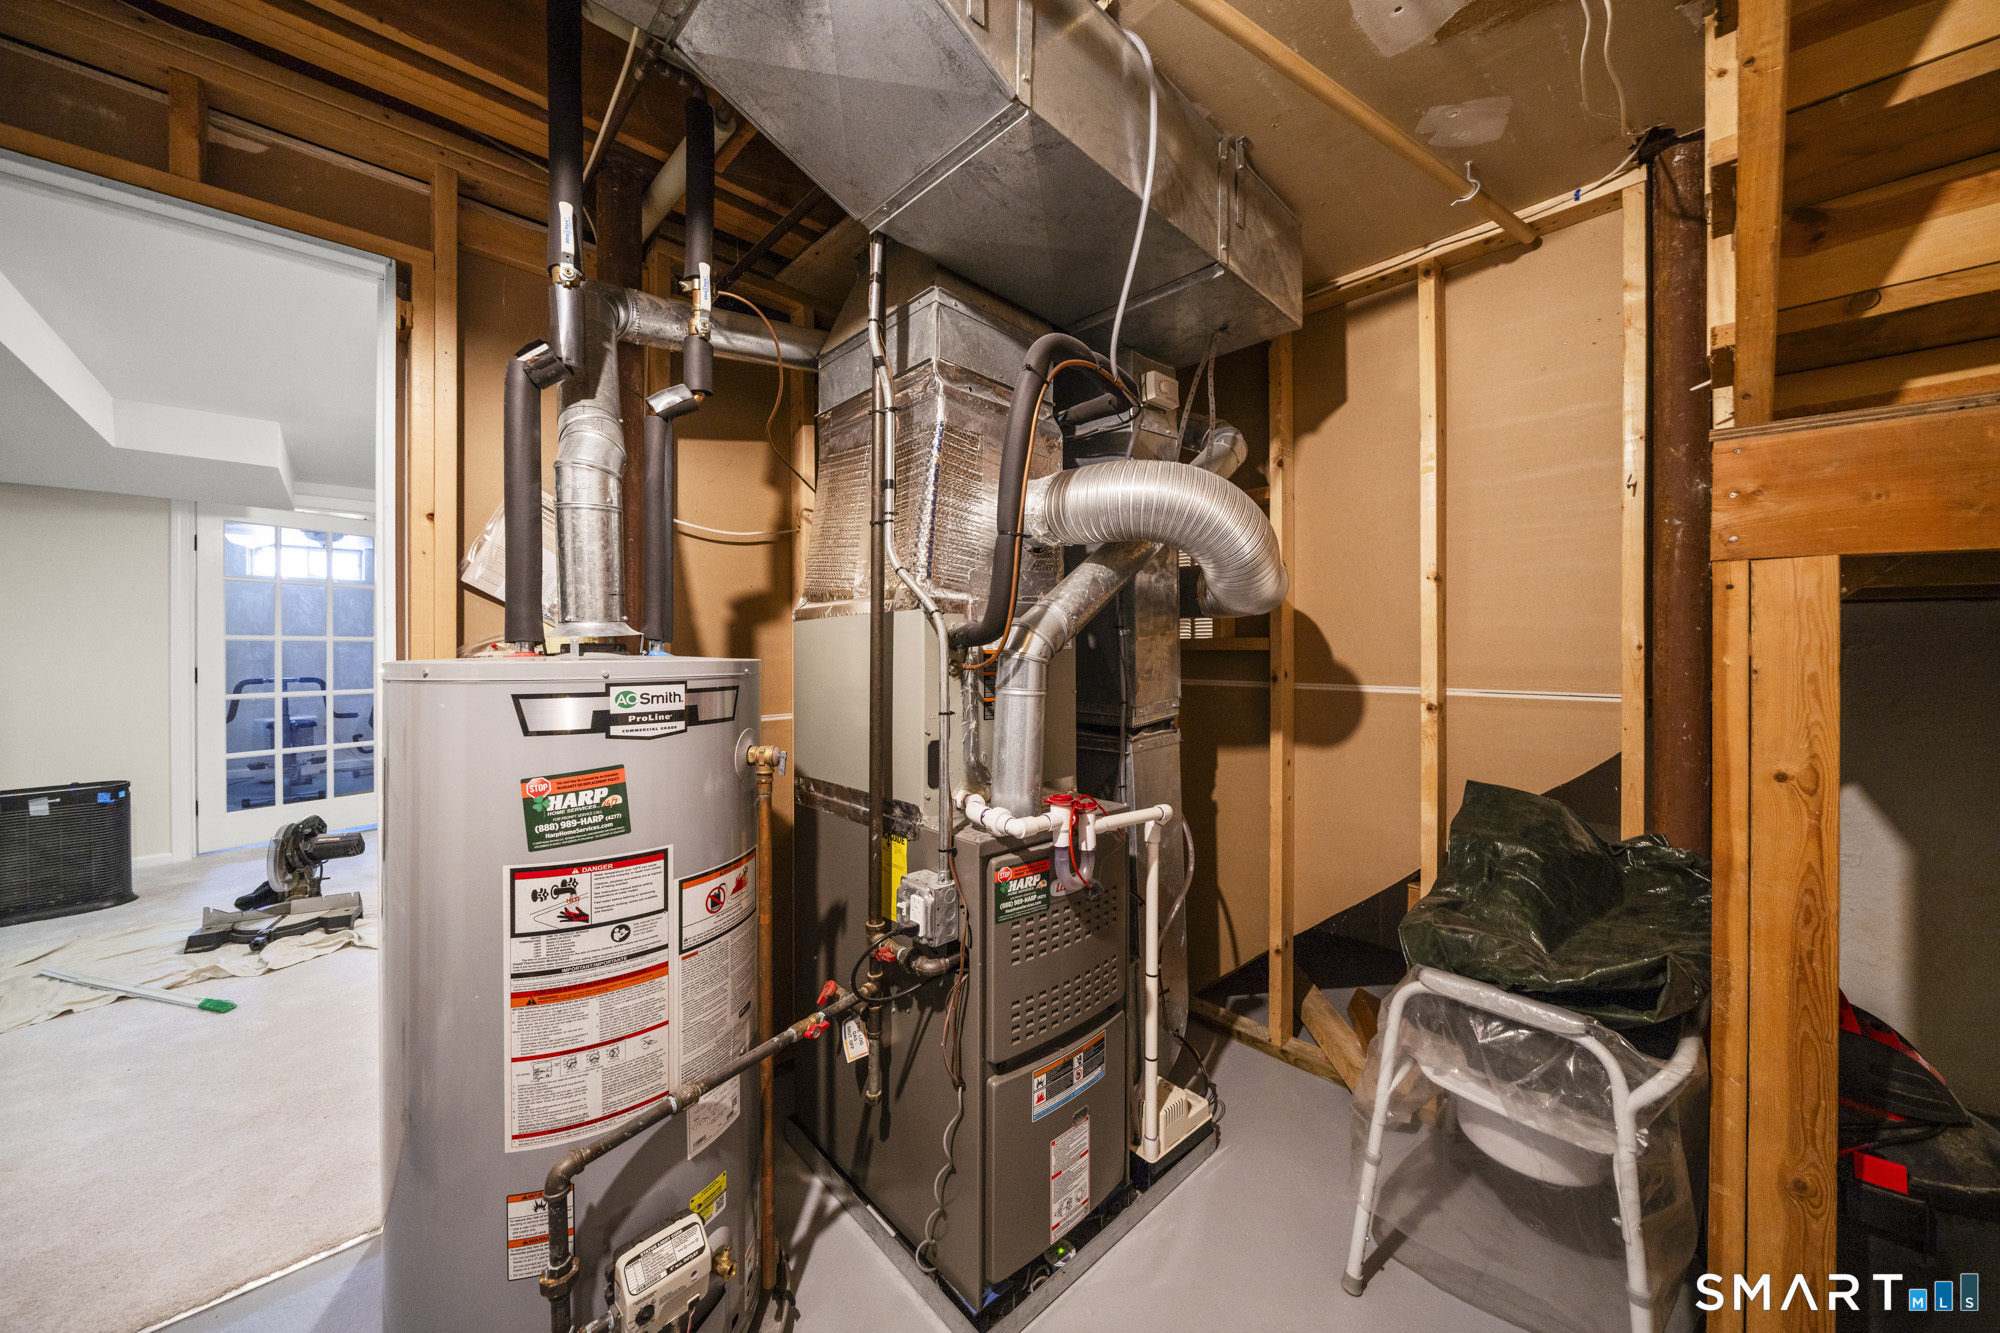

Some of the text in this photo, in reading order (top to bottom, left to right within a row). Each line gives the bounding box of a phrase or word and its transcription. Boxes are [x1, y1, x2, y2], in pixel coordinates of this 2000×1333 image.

[628, 714, 670, 722] ProLine
[529, 783, 548, 793] STOP
[546, 787, 608, 811] HARP
[566, 804, 597, 814] SERVICES
[534, 822, 558, 834] (888)
[560, 814, 604, 828] 989-HARP
[545, 822, 614, 838] HarpHomeServices.com
[582, 864, 613, 873] DANGER
[1000, 871, 1010, 879] STOP
[1007, 874, 1041, 892] HARP
[566, 896, 580, 904] HOT
[564, 984, 584, 992] SAFETY
